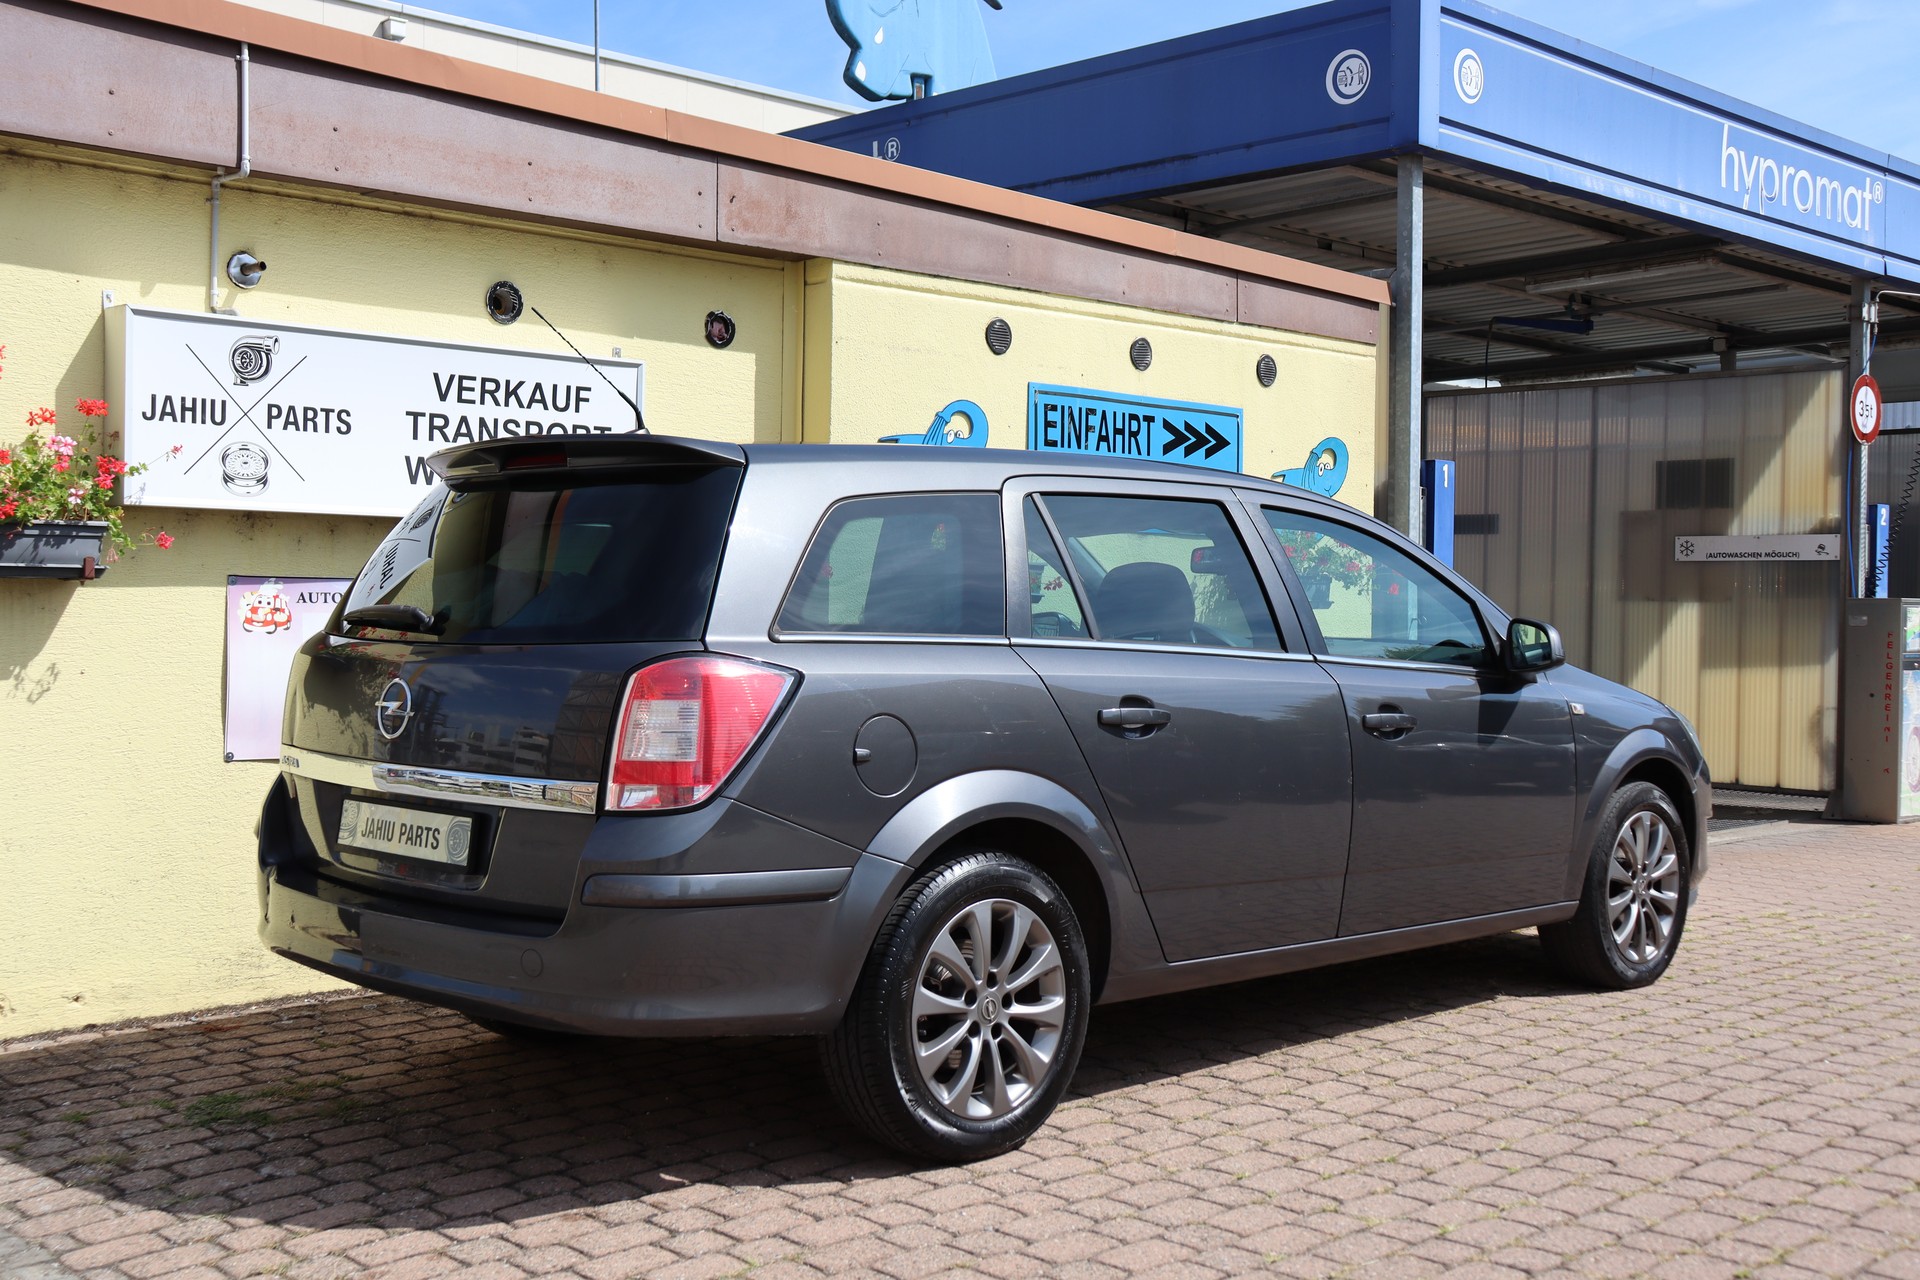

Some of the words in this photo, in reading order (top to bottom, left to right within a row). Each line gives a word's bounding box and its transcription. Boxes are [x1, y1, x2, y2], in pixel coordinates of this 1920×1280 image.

[433, 372, 592, 413] VERKAUF
[142, 394, 227, 426] JAHIU
[267, 403, 352, 435] PARTS
[405, 411, 612, 443] TRANSP
[1044, 403, 1155, 456] EINFAHRT
[1442, 463, 1448, 488] 1
[1880, 507, 1887, 526] 2
[1705, 551, 1763, 560] (AUTOWASCHEN
[1764, 549, 1800, 559] MÖGLICH)
[361, 817, 396, 842] JAHIU
[398, 823, 440, 850] PARTS
